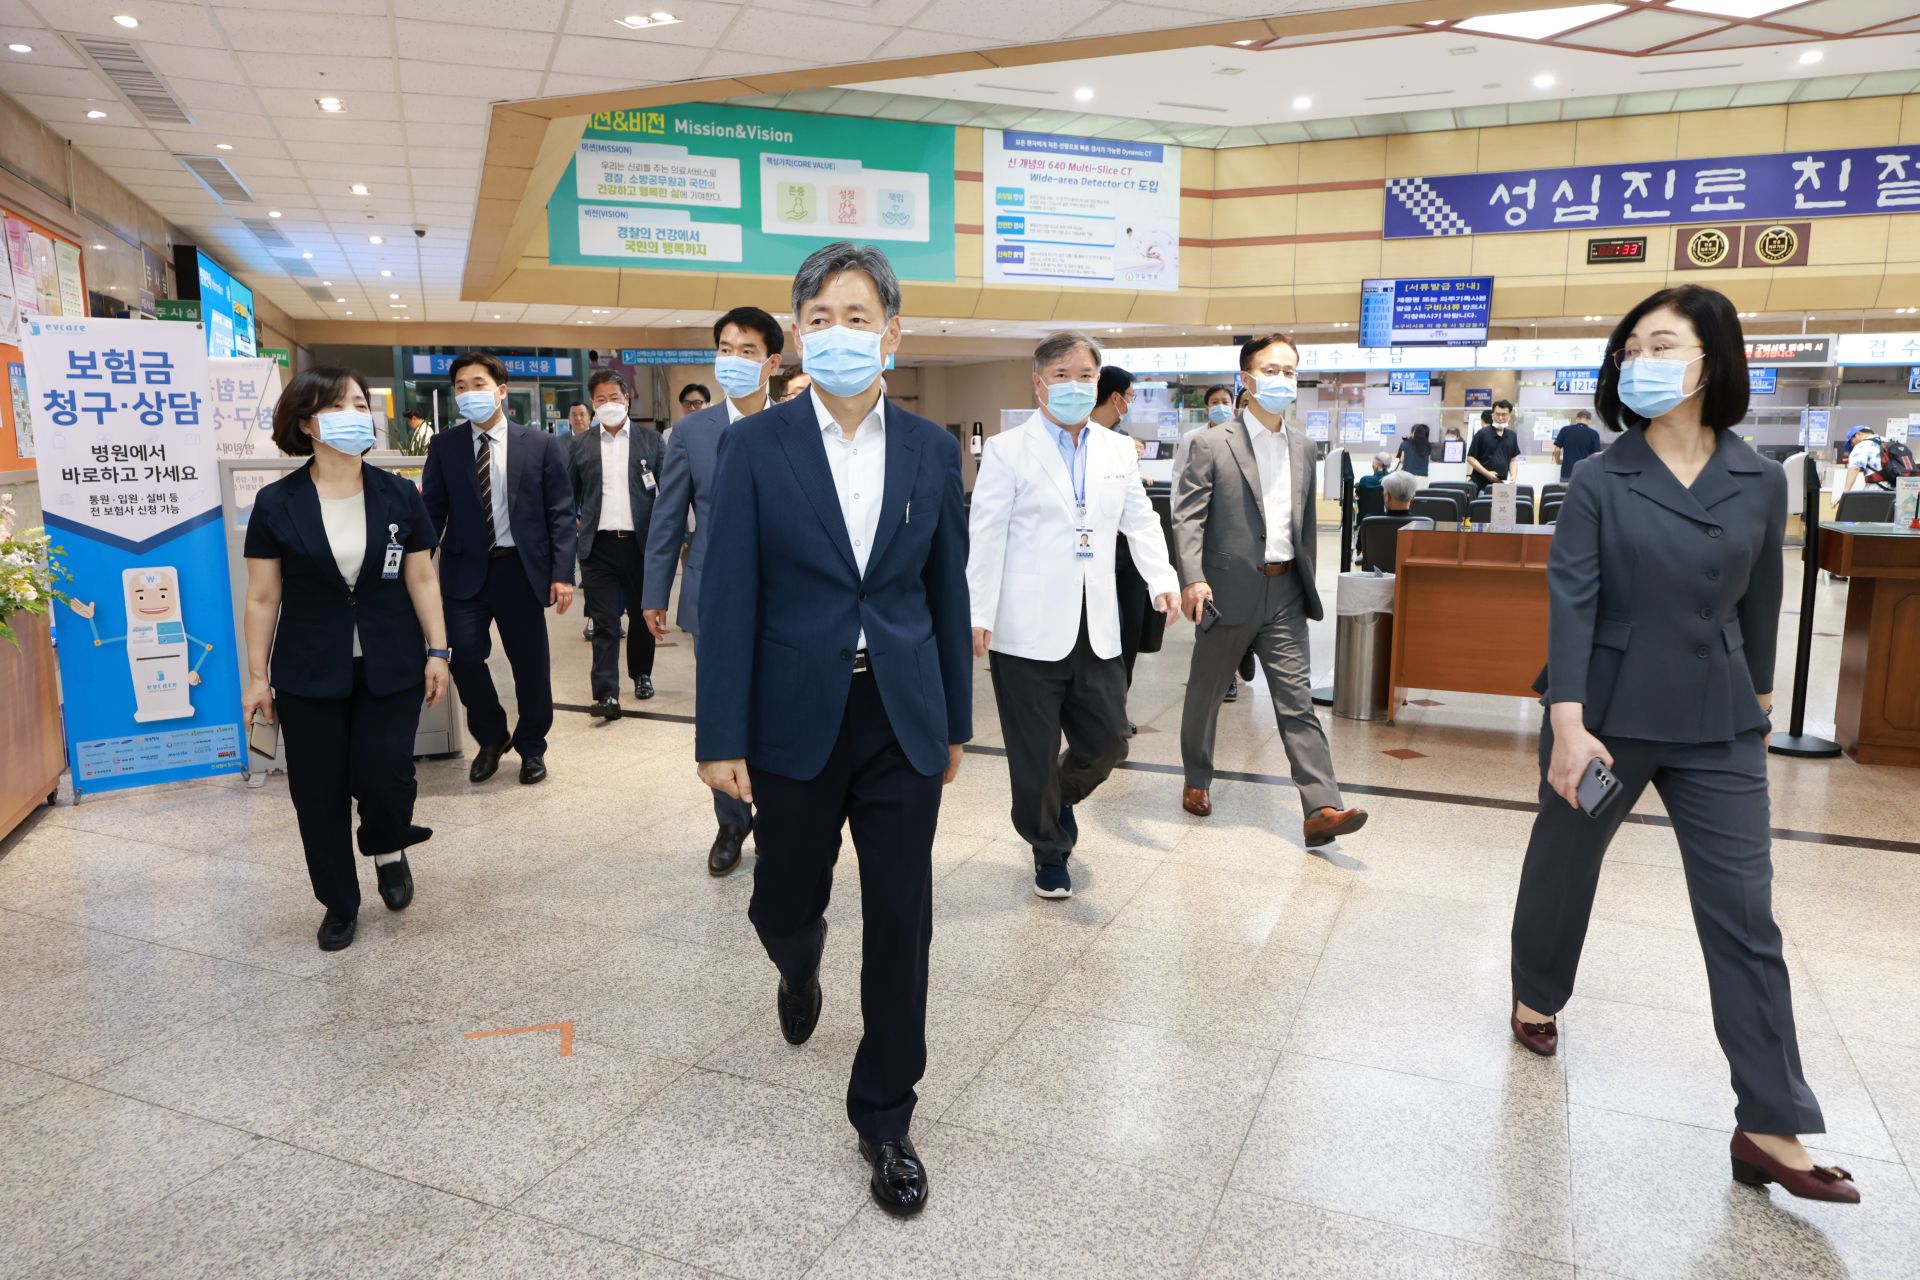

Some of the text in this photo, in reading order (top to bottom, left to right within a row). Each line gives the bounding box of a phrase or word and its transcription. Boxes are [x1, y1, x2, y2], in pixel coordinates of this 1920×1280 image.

[674, 118, 793, 143] Mission&Vision
[581, 143, 632, 155] 미션(MISSION)
[1121, 148, 1144, 157] Dynamic
[601, 161, 717, 178] 우리는 신뢰를 주는 의료서비스로
[813, 159, 836, 171] VALUE)
[1008, 158, 1133, 176] 신 개념의 640 Multi-Slice CT
[604, 172, 716, 190] 경찰, 소방공무원과 국민의
[1030, 172, 1159, 193] Wide-area Detector CT 도입
[597, 184, 636, 196] 건강하고
[639, 186, 668, 198] 행복한
[1489, 168, 1746, 226] 성심진료
[584, 209, 629, 219] 비전(VISION)
[617, 226, 700, 242] 경찰의 건강에서
[625, 240, 707, 256] 국민의 행복까지
[1404, 282, 1451, 293] [서류발급
[1456, 281, 1480, 292] 안내]
[155, 307, 198, 318] 주사실
[66, 348, 174, 385] 보험금
[529, 360, 550, 373] 전용
[1393, 381, 1400, 391] 3
[1559, 380, 1597, 391] 4 1214
[42, 389, 202, 426] 청구·상담
[91, 444, 166, 462] 병원에서
[61, 465, 198, 485] 바로하고 가세요
[89, 492, 179, 505] 통원 입원 실비 등
[90, 504, 180, 516] 전 보험사 신청 가능
